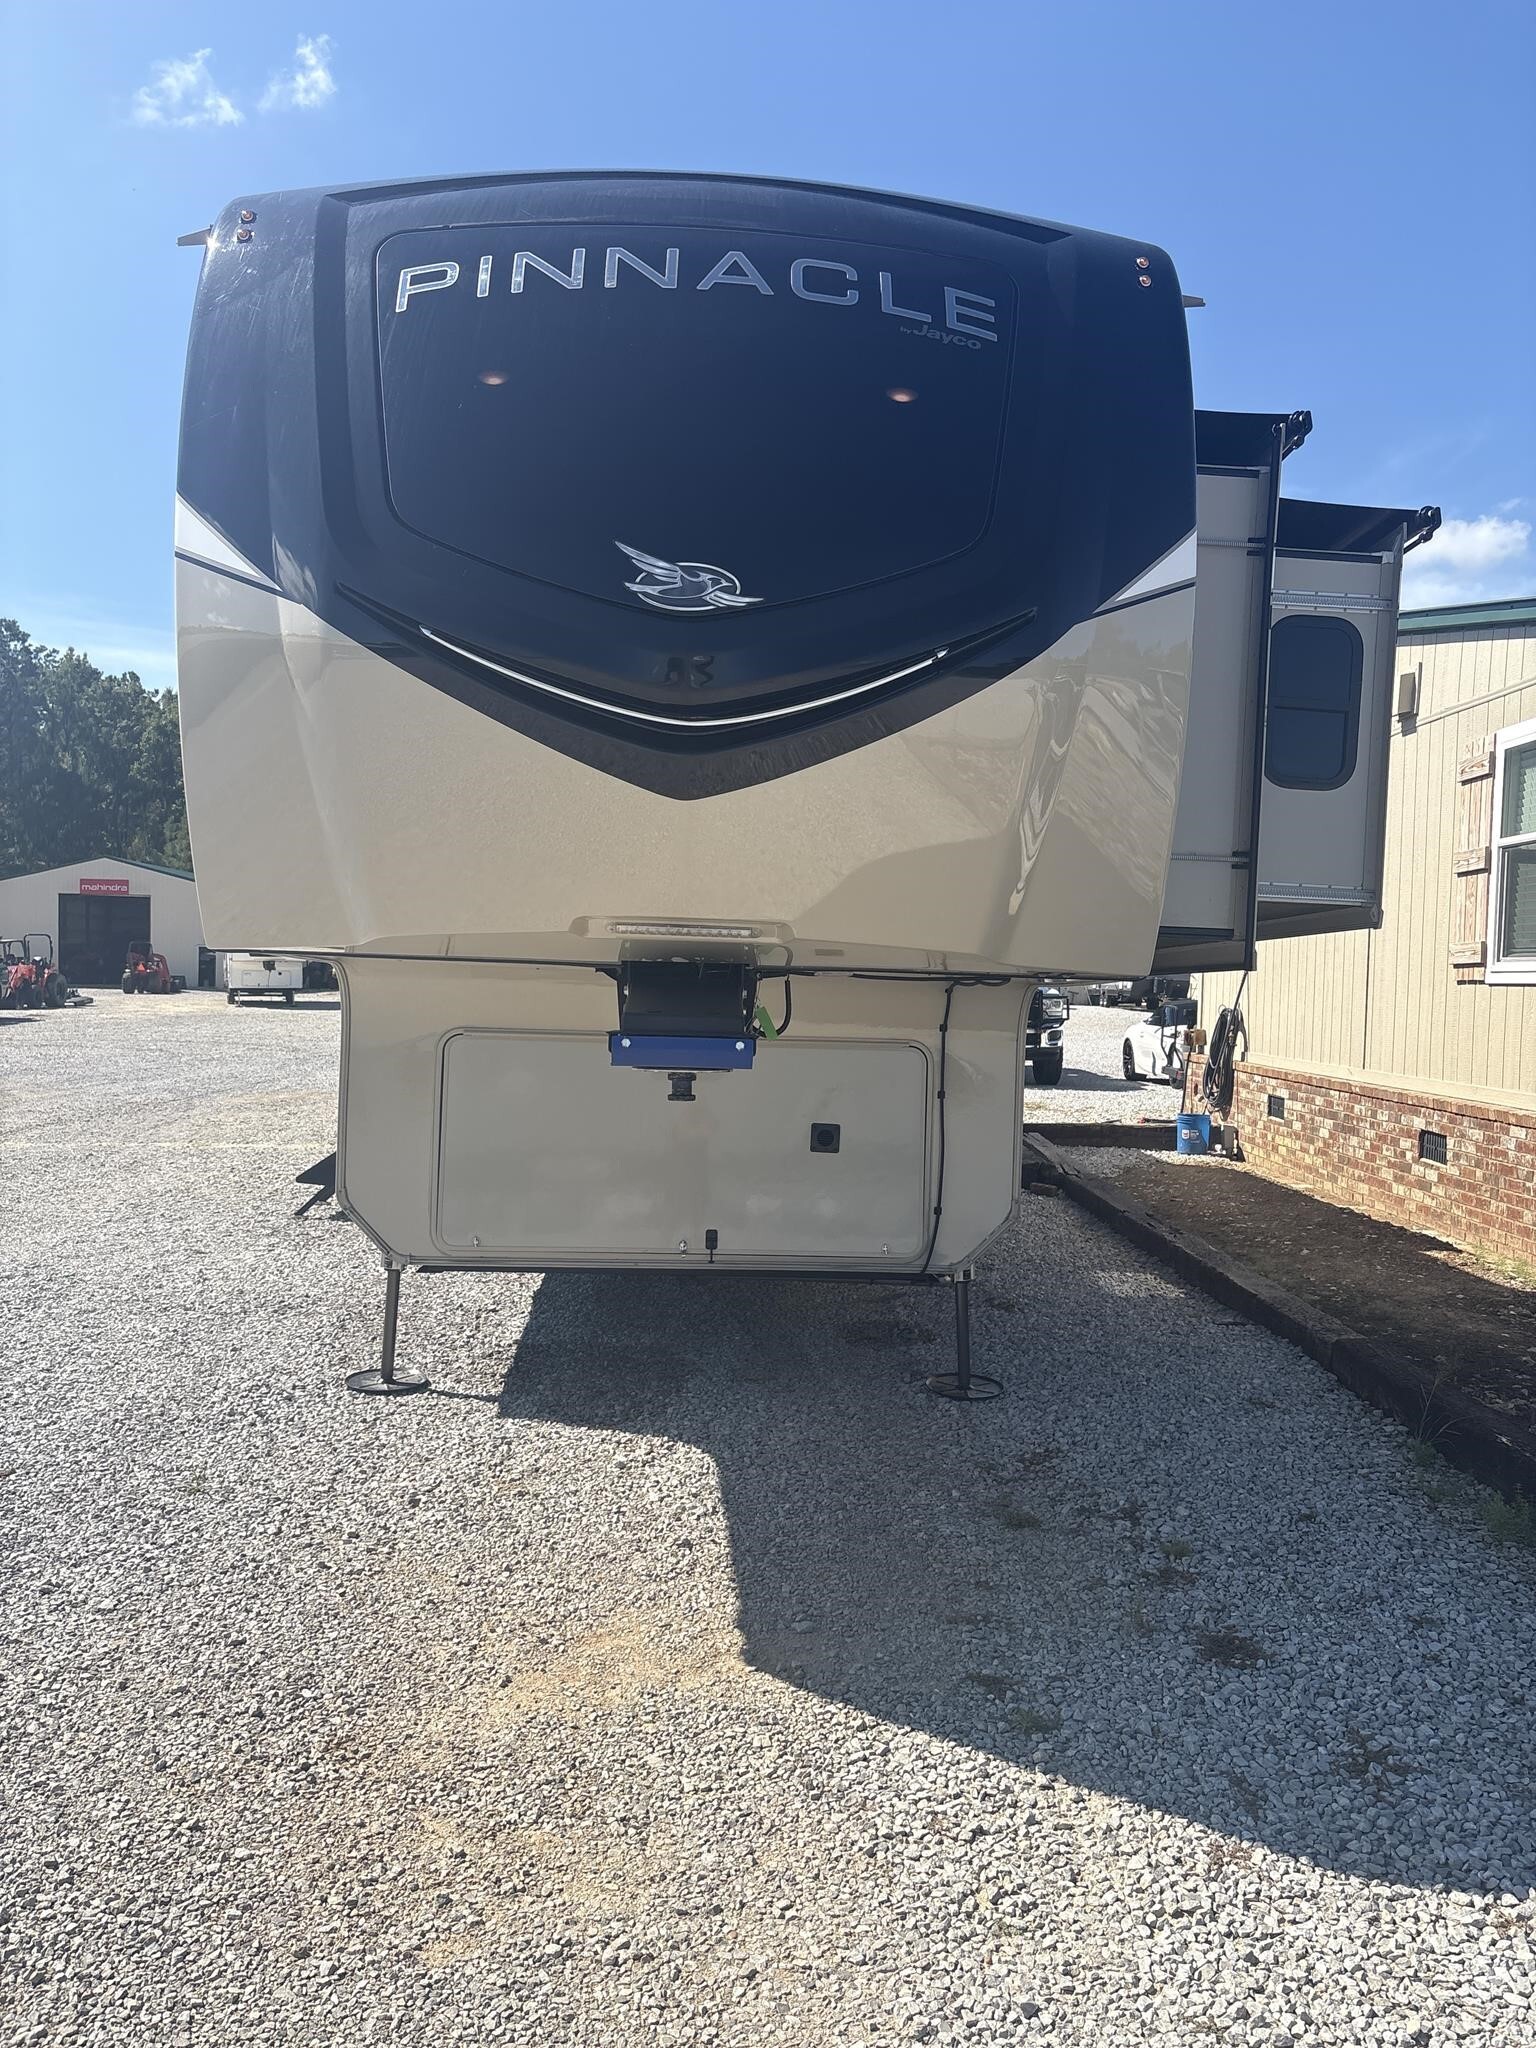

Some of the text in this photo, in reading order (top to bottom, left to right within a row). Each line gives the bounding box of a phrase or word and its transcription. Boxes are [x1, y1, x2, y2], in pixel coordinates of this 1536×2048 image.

[395, 247, 998, 342] PINNACLE
[912, 324, 982, 350] Jayco
[81, 883, 128, 892] mahindra
